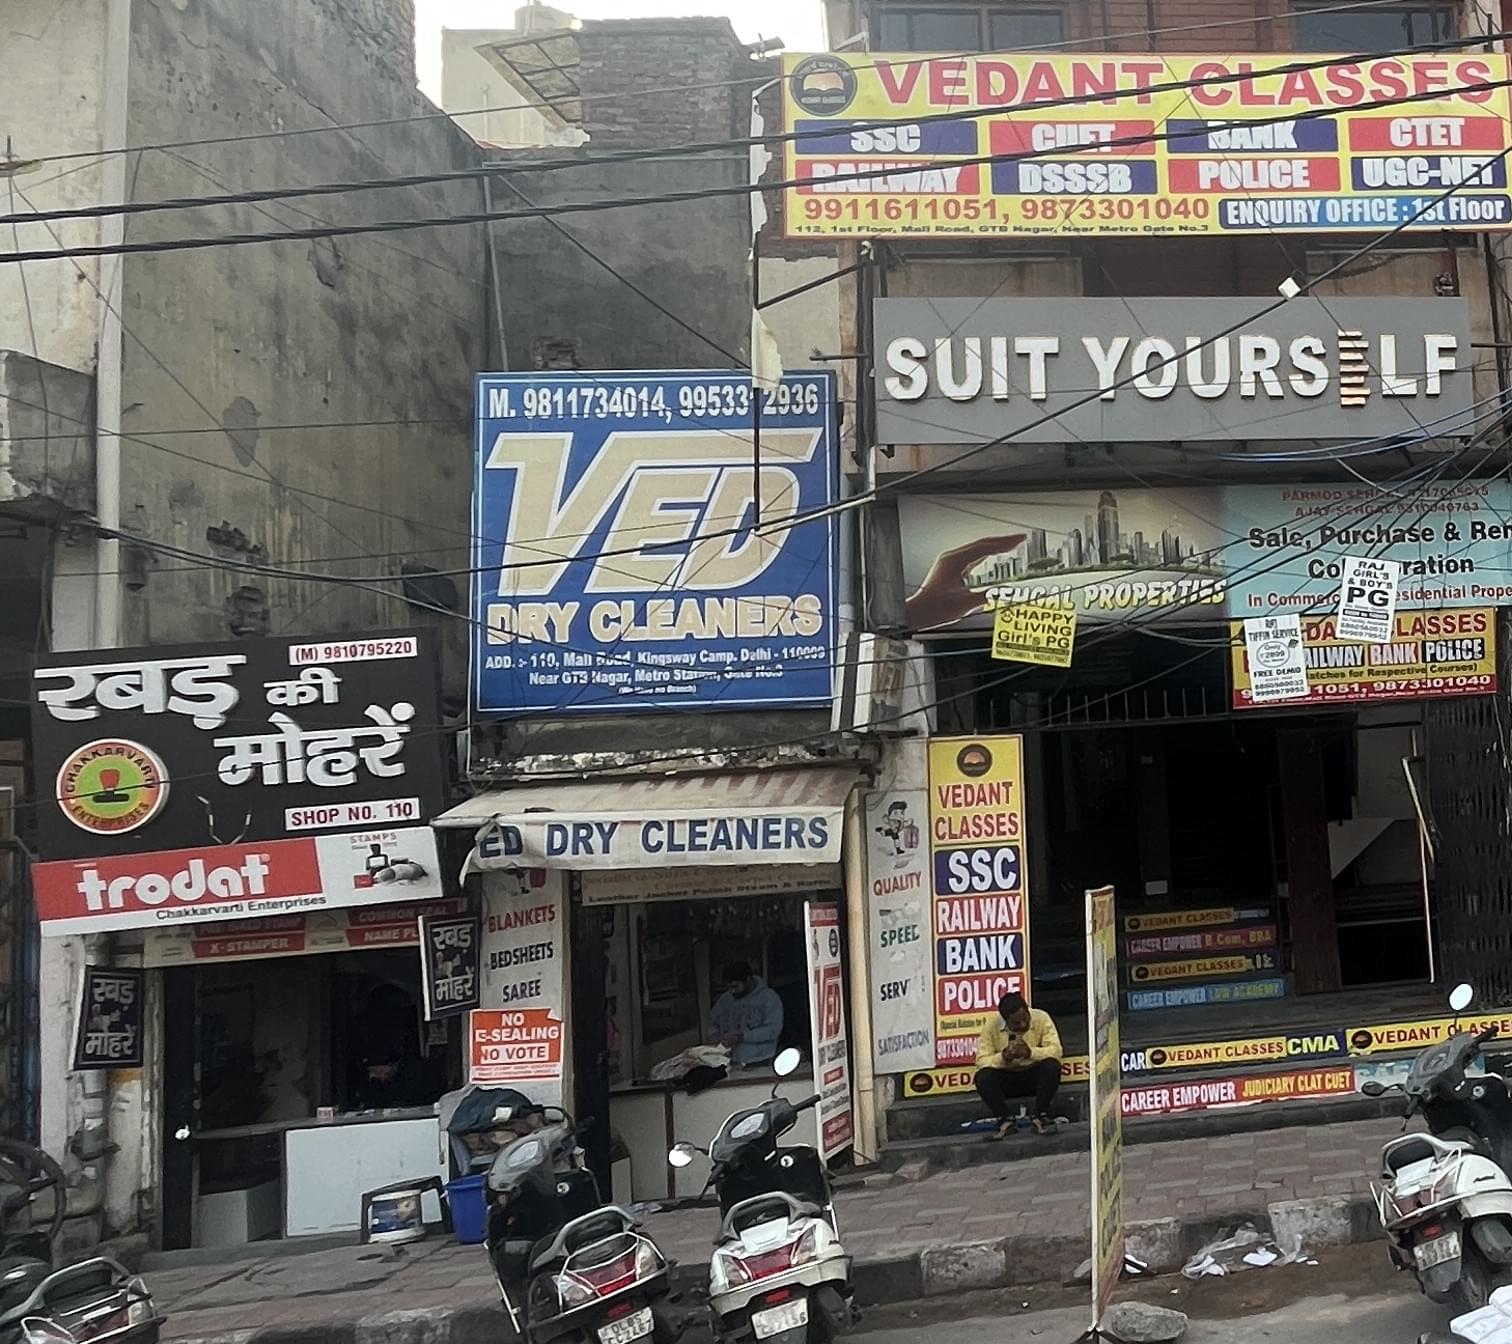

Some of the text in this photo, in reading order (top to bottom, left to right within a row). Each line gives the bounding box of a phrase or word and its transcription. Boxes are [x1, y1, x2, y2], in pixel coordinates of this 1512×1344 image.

[873, 58, 1496, 107] VEDANT CLASSES
[850, 121, 921, 153] SSC
[1207, 119, 1298, 150] BANK
[1390, 117, 1466, 147] CTET
[811, 162, 962, 193] RAILWAY
[1019, 163, 1132, 194] DSSSB
[1198, 160, 1311, 190] POLICE
[1362, 156, 1497, 186] UGC-NET
[804, 197, 1209, 224] 9911611051, 9873301040
[1227, 197, 1504, 226] ENQUIRY OFFICE 1st Floor
[1099, 225, 1139, 233] Metro
[883, 335, 1060, 402] SUIT
[488, 383, 818, 425] M. 9811734014, 995332936
[485, 427, 823, 597] VED
[1248, 528, 1312, 550] Sale,
[1320, 524, 1435, 547] Purchase
[1443, 522, 1462, 542] &
[1352, 568, 1390, 581] GIRL'S
[1358, 560, 1385, 571] RAJ
[984, 577, 1228, 612] SEHGAL PROPERTIES
[1346, 586, 1390, 608] PG
[1359, 578, 1393, 590] BOY'S
[1248, 594, 1263, 608] In
[487, 593, 823, 646] DRY CLEANERS
[1014, 609, 1075, 624] HAPPY
[1014, 622, 1073, 637] LIVING
[1395, 613, 1488, 637] LASSES
[997, 630, 1071, 649] Girl's PG
[1248, 631, 1270, 642] TIFFIN
[1271, 627, 1299, 640] SERVICE
[296, 640, 413, 664] (M) 9810795220
[637, 647, 771, 669] Kingsway Camp. Delhi
[1369, 639, 1483, 664] BANK POLICE
[529, 669, 670, 687] Near Metro
[1367, 663, 1478, 677] Respective Courses)
[1373, 674, 1491, 690] 9873301040
[33, 654, 343, 730] रबड़ की
[213, 701, 416, 787] मोहरें
[937, 780, 1014, 810] VEDANT
[291, 800, 414, 827] SHOP NO. 110
[933, 812, 1019, 842] CLASSES
[350, 832, 398, 844] STAMPS
[546, 815, 829, 857] DRY CLEANERS
[78, 853, 271, 911] trodat
[872, 870, 923, 897] QUALITY
[947, 846, 1017, 894] SSC
[247, 895, 327, 913] Enterprises
[936, 895, 1022, 935] RAILWAY
[1186, 909, 1233, 923] CLASSES
[488, 903, 556, 934] BLANKETS
[209, 937, 289, 956] X-STAMPER
[364, 928, 401, 943] NAME
[1162, 933, 1203, 952] EMPOWER
[489, 941, 555, 971] BEDSHEETS
[945, 934, 1017, 974] BANK
[1149, 963, 1194, 977] VEDANT
[1196, 959, 1244, 973] CLASSES
[502, 979, 543, 1003] SAREE
[1132, 982, 1280, 1009] CAREER EMPOWER ACADEMY
[501, 1012, 525, 1027] NO
[877, 1028, 930, 1057] SATISFACTION
[1286, 1035, 1341, 1057] CMA
[1373, 1026, 1441, 1047] VEDANT
[505, 1044, 546, 1060] VOTE
[1167, 1040, 1285, 1062] VEDANT CLASSES
[1121, 1088, 1171, 1113] CAREER
[1173, 1081, 1237, 1106] EMPOWER
[1242, 1074, 1296, 1099] JUDICIARY
[1297, 1072, 1324, 1092] CLAT
[1325, 1070, 1352, 1091] CUET
